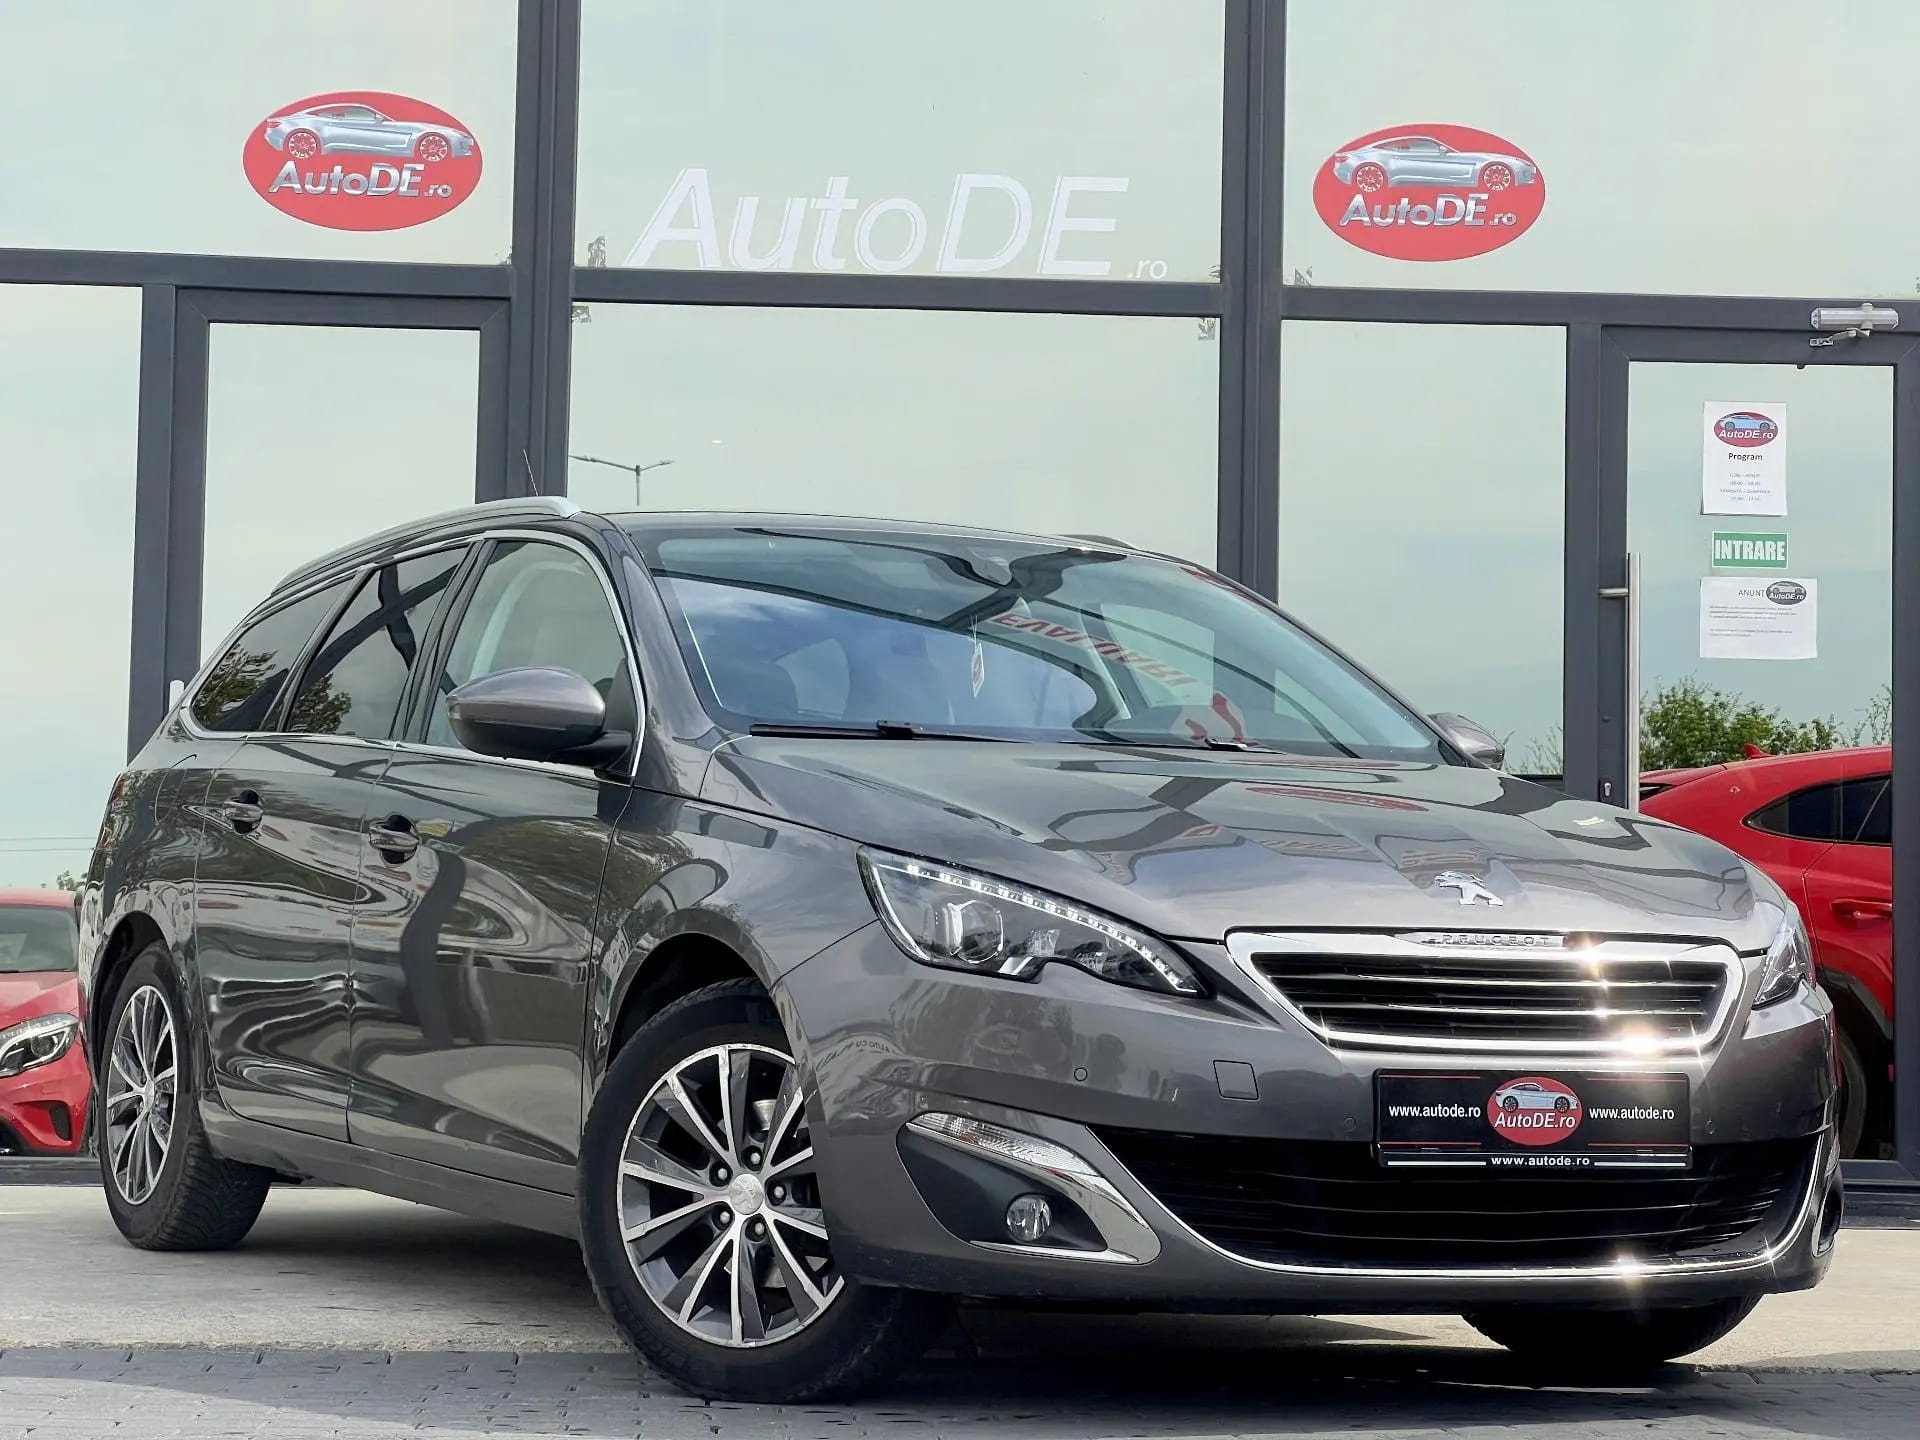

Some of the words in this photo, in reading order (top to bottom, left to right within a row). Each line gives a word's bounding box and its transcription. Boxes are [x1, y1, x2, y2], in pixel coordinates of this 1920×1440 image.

[1719, 429, 1774, 440] AutoDE.ro
[1728, 452, 1763, 462] Program
[1714, 539, 1786, 561] INTRARE
[1441, 934, 1550, 947] PEUGEOT
[1388, 1103, 1482, 1118] www.autode.ro
[1588, 1106, 1675, 1120] www.autode.ro
[1494, 1112, 1577, 1129] AutoDE.ro
[1491, 1156, 1590, 1167] www.autode.ro
